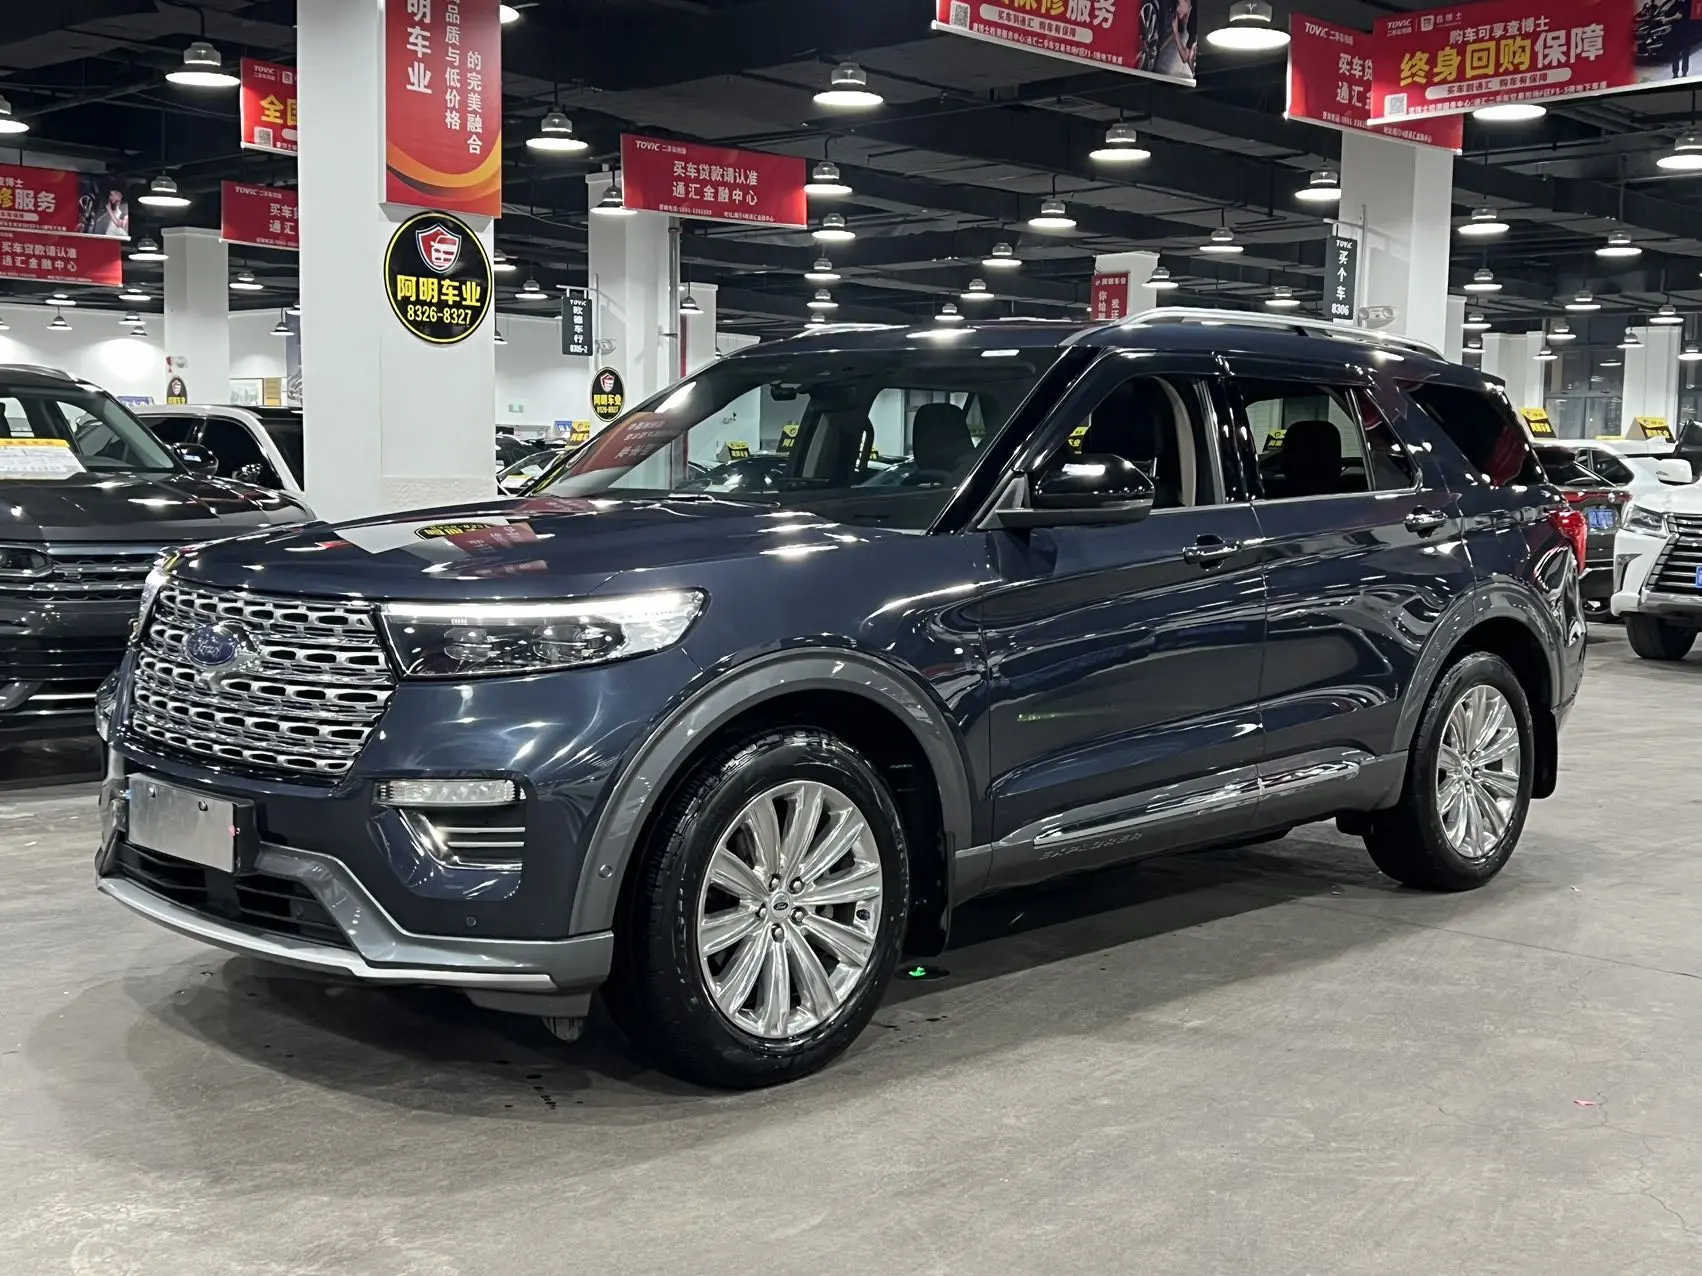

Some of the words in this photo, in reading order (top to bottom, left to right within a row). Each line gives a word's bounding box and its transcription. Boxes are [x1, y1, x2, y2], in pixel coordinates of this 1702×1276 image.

[1304, 22, 1330, 38] TOVIC
[1449, 16, 1550, 45] 购车可享查博士
[445, 0, 461, 131] 品质与低价格
[1399, 23, 1605, 87] 终身回购保障
[467, 51, 483, 155] 的完美融合
[635, 141, 660, 151] TOVIC
[673, 161, 758, 186] 买车贷款请认准
[672, 181, 758, 206] 通汇金融中心
[1336, 251, 1348, 301] 买个车
[397, 274, 481, 307] 阿明车业
[407, 304, 472, 325] 8326-8327
[1331, 303, 1349, 316] 8306
